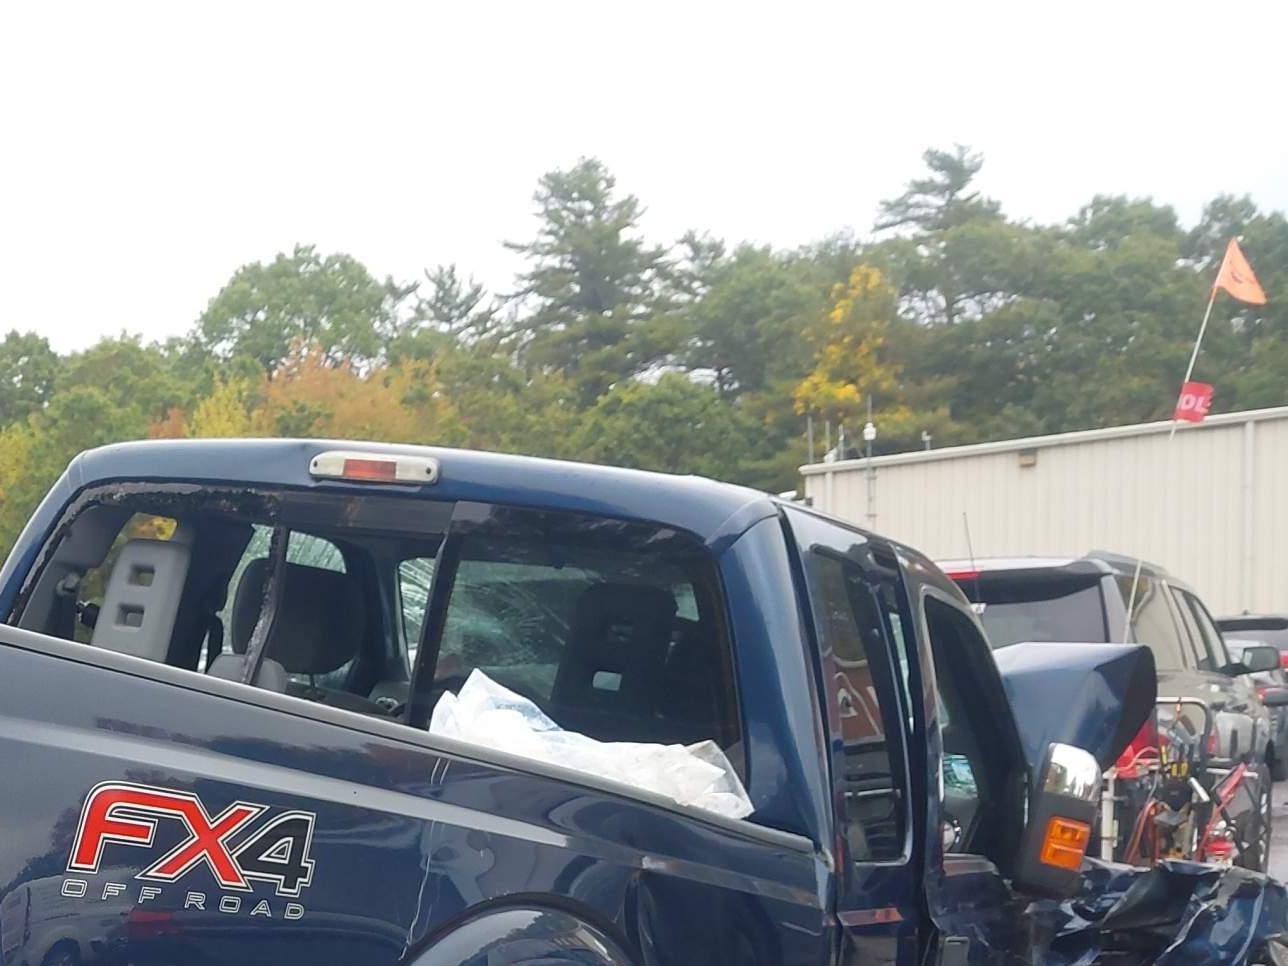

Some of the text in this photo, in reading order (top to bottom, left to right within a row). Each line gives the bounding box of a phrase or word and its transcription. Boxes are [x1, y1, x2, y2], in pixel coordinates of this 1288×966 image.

[66, 780, 317, 898] FX4
[61, 878, 306, 920] OFF ROAD
